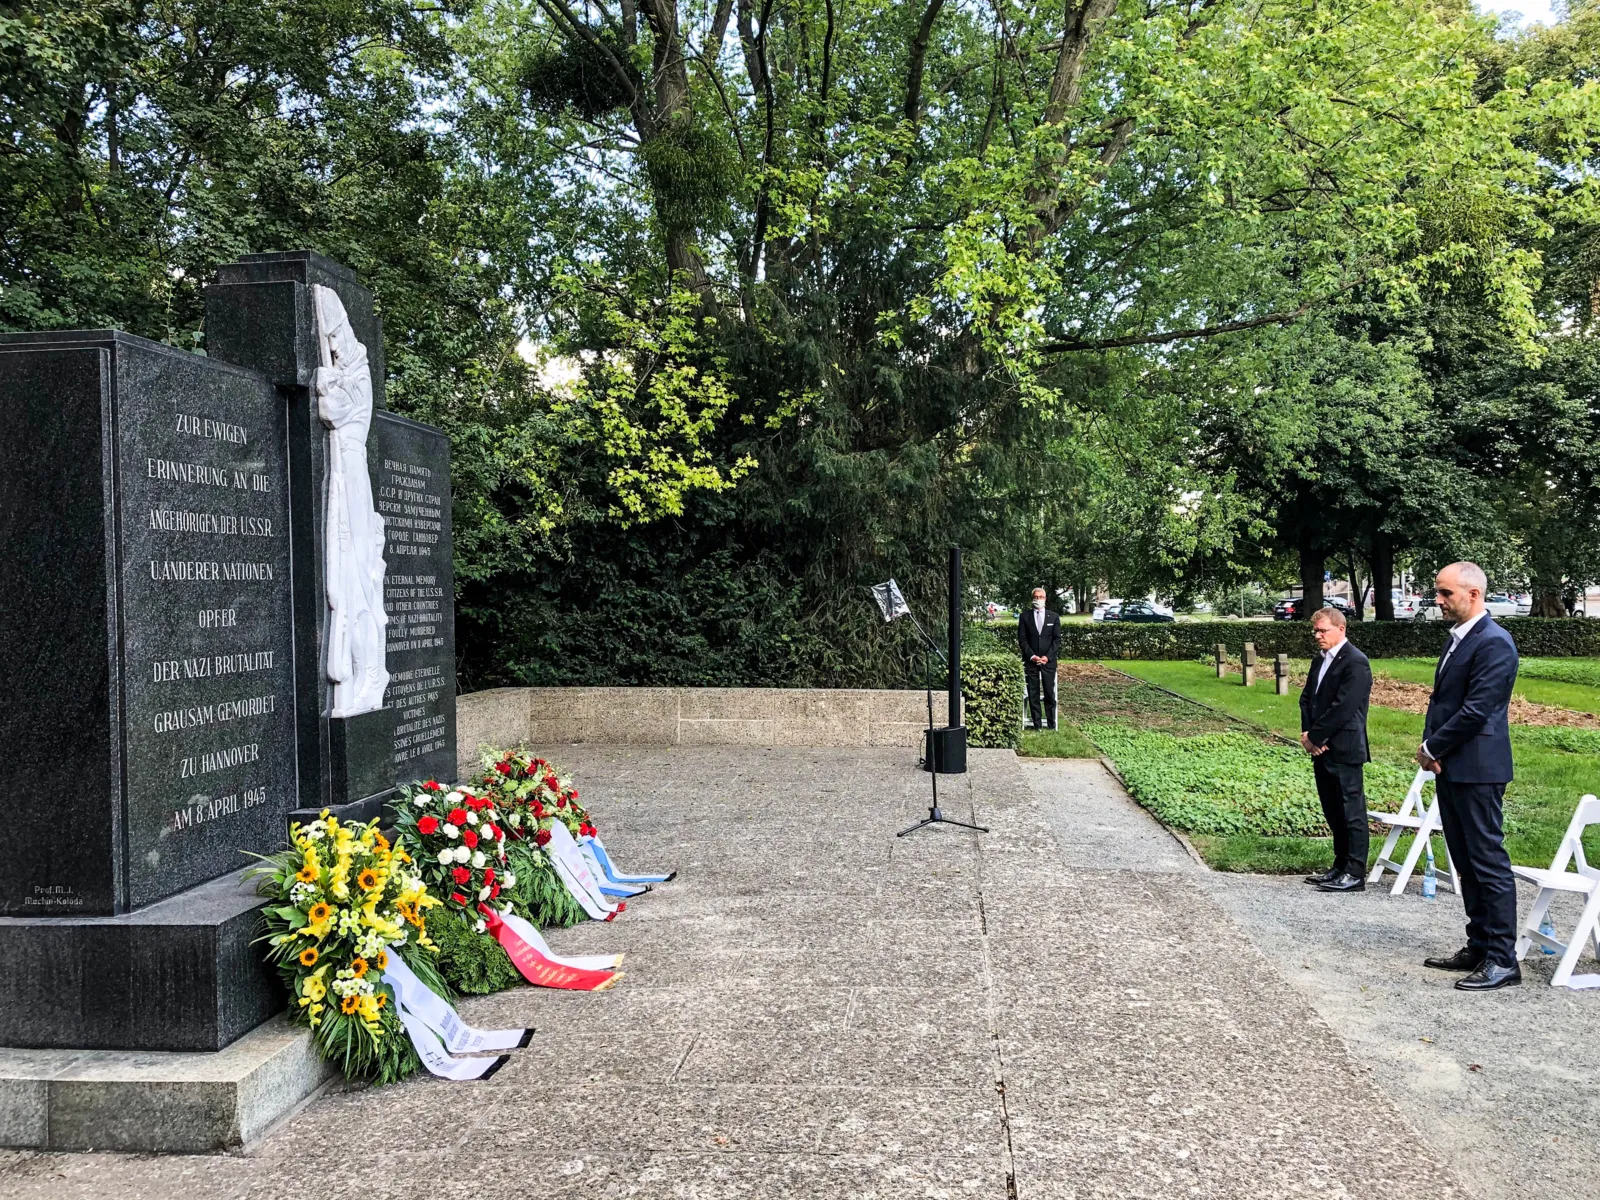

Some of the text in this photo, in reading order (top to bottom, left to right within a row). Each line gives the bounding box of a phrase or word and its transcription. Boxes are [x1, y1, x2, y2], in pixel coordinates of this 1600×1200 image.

[176, 414, 248, 445] ZUR EWIGEN
[148, 458, 271, 493] ERINNERUNG AN DIE
[384, 459, 431, 478] ВЕЧНАЯ ПАМЯТЬ
[378, 500, 401, 513] ВЕРСКИ
[149, 509, 274, 537] ANGEHÖRIGEN DER U.S.S.R.
[222, 562, 273, 580] NATIONEN
[391, 575, 415, 585] ETERNAL
[415, 575, 436, 586] MEMORY
[198, 608, 237, 628] OPFER
[153, 660, 180, 682] DER
[184, 657, 211, 679] NAZI
[154, 694, 276, 733] GRAUSAM GEMORDET
[181, 743, 259, 779] ZU HANNOVER
[173, 807, 192, 832] AM
[243, 786, 266, 809] 1945
